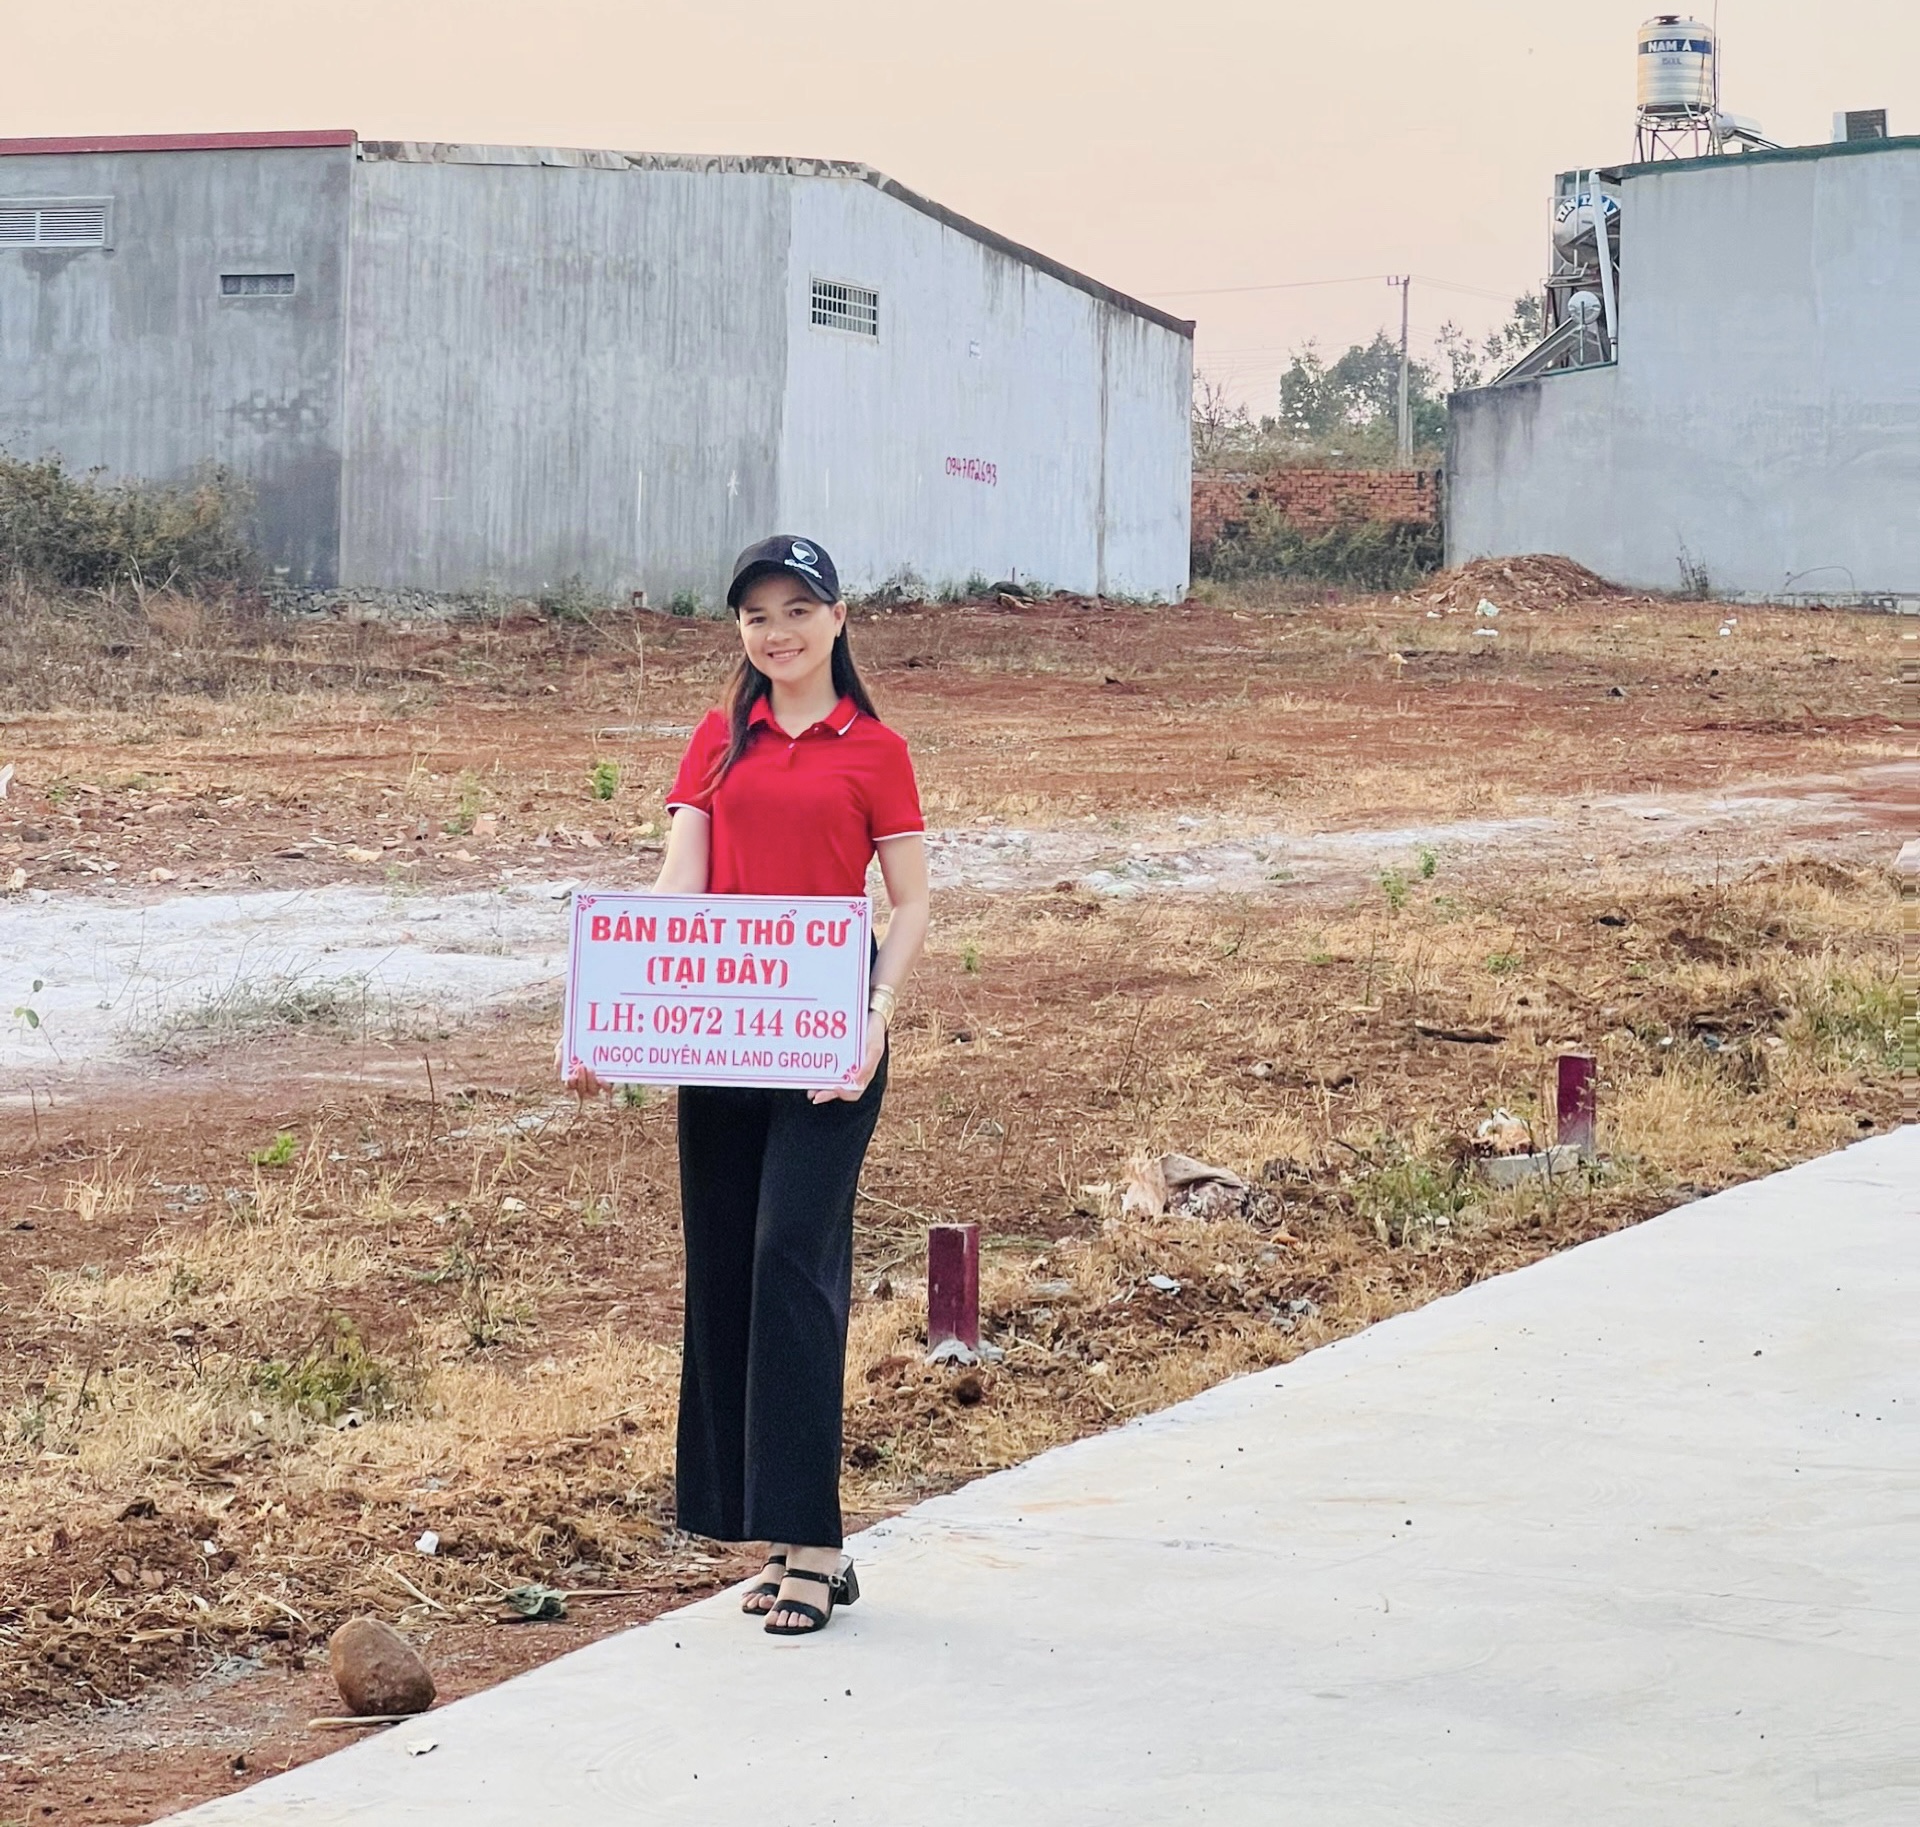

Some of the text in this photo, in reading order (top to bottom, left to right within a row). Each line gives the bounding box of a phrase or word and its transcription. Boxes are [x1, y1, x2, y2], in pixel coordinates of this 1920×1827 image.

[1648, 41, 1678, 52] NAM
[591, 908, 852, 947] BÁN ĐẤT THỔ CƯ
[647, 952, 788, 989] (TẠI ĐÂY)
[586, 1001, 847, 1039] LH: 0972 144 688
[592, 1043, 839, 1074] (NGỌC DUYÊN AN LAND GROUP)
